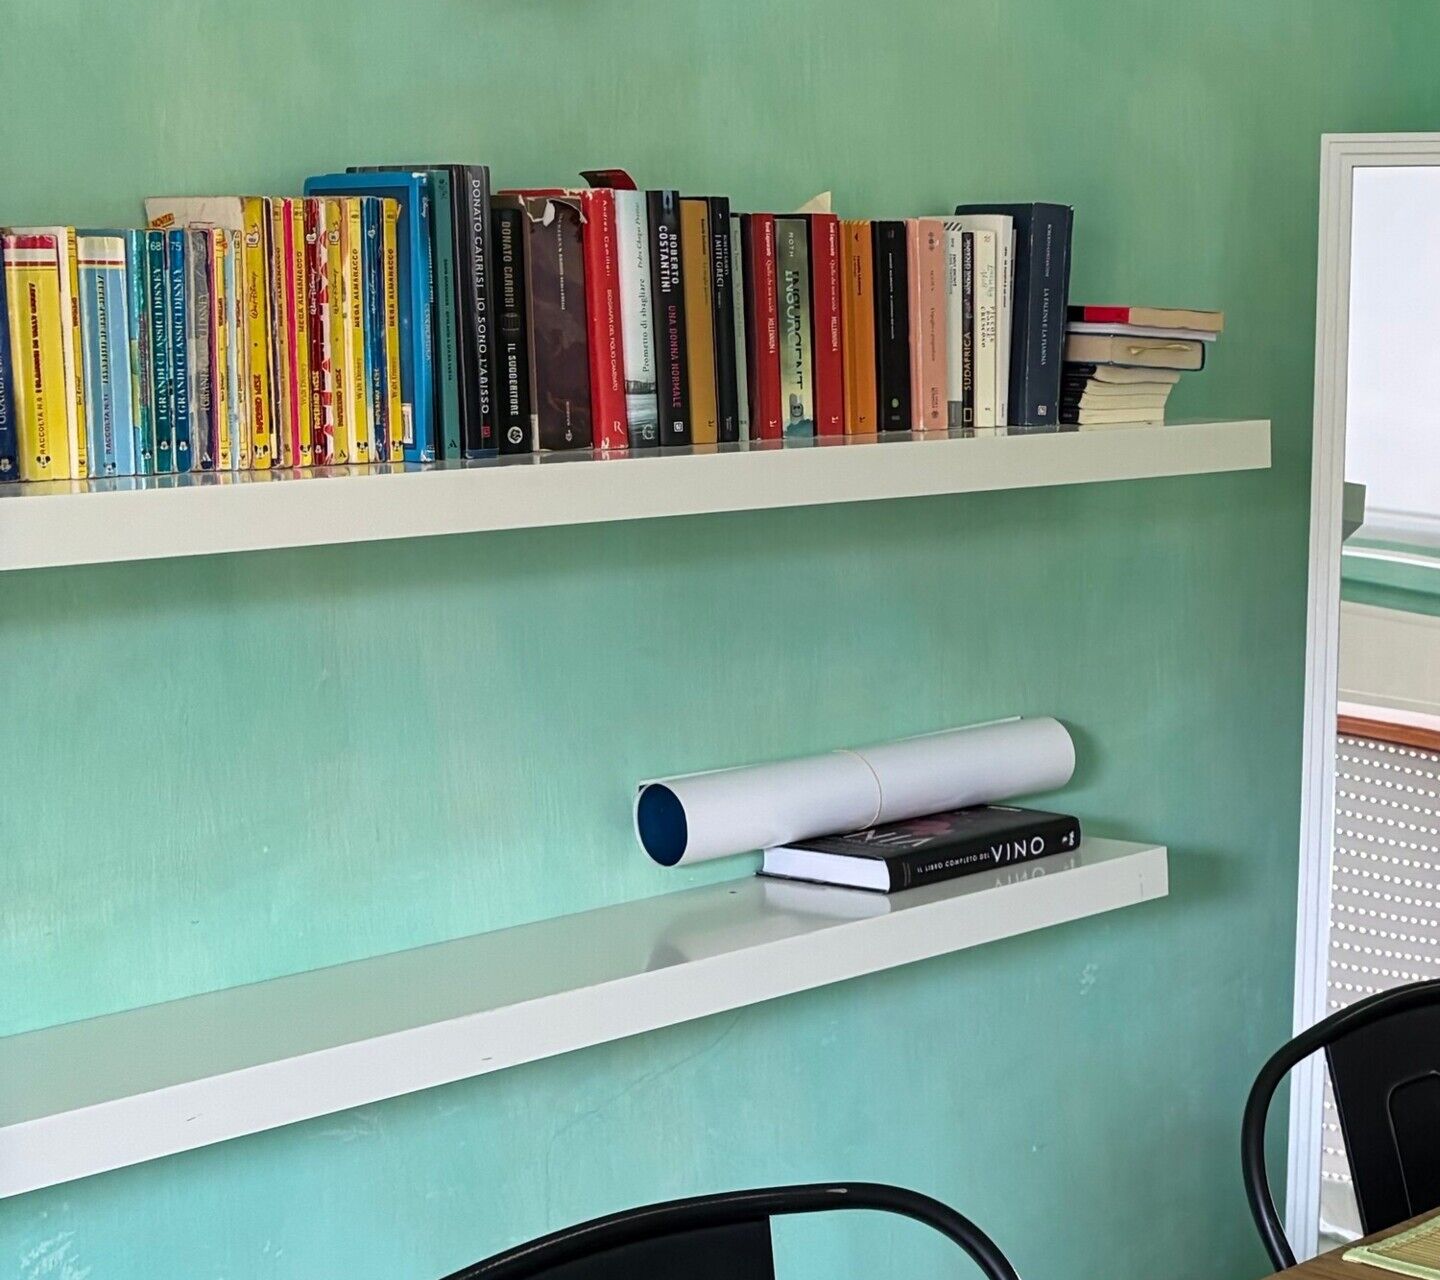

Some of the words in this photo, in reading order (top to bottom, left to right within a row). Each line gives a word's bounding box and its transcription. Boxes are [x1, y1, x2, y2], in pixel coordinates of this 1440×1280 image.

[472, 179, 482, 232] DONATO
[150, 241, 163, 252] 68
[170, 241, 183, 252] 75
[474, 236, 484, 288] CARRISI
[501, 221, 512, 262] DONATO
[659, 225, 671, 293] COSTANTINI
[669, 233, 680, 284] ROBERTO
[153, 266, 162, 309] DISNEY
[173, 267, 183, 309] DISNEY
[387, 249, 395, 301] ALMANACCO
[504, 266, 514, 308] CARRISI
[477, 297, 487, 312] IO
[606, 289, 614, 323] BIOGRAFIA
[638, 279, 648, 317] sbagliare
[668, 305, 676, 325] UNA
[154, 311, 166, 366] CLASSICI
[174, 311, 185, 365] CLASSICI
[477, 316, 487, 356] SONO
[508, 343, 516, 351] IL
[609, 337, 617, 358] FIGLIO
[641, 329, 650, 372] Prometto
[669, 328, 678, 360] DONNA
[784, 270, 803, 389] INSURGENT
[963, 332, 972, 391] SUDAFRICA
[157, 368, 167, 414] GRANDI
[176, 368, 187, 414] GRANDI
[479, 359, 489, 415] L'ABISSO
[508, 355, 518, 416] SUGGERITORE
[671, 363, 681, 408] NORMALE
[37, 411, 46, 455] RACCOLTA
[104, 411, 112, 455] RACCOLTA
[925, 863, 944, 872] LIBRO
[945, 855, 979, 869] COMPLETO
[979, 852, 991, 861] DEL
[991, 836, 1045, 863] VINO
